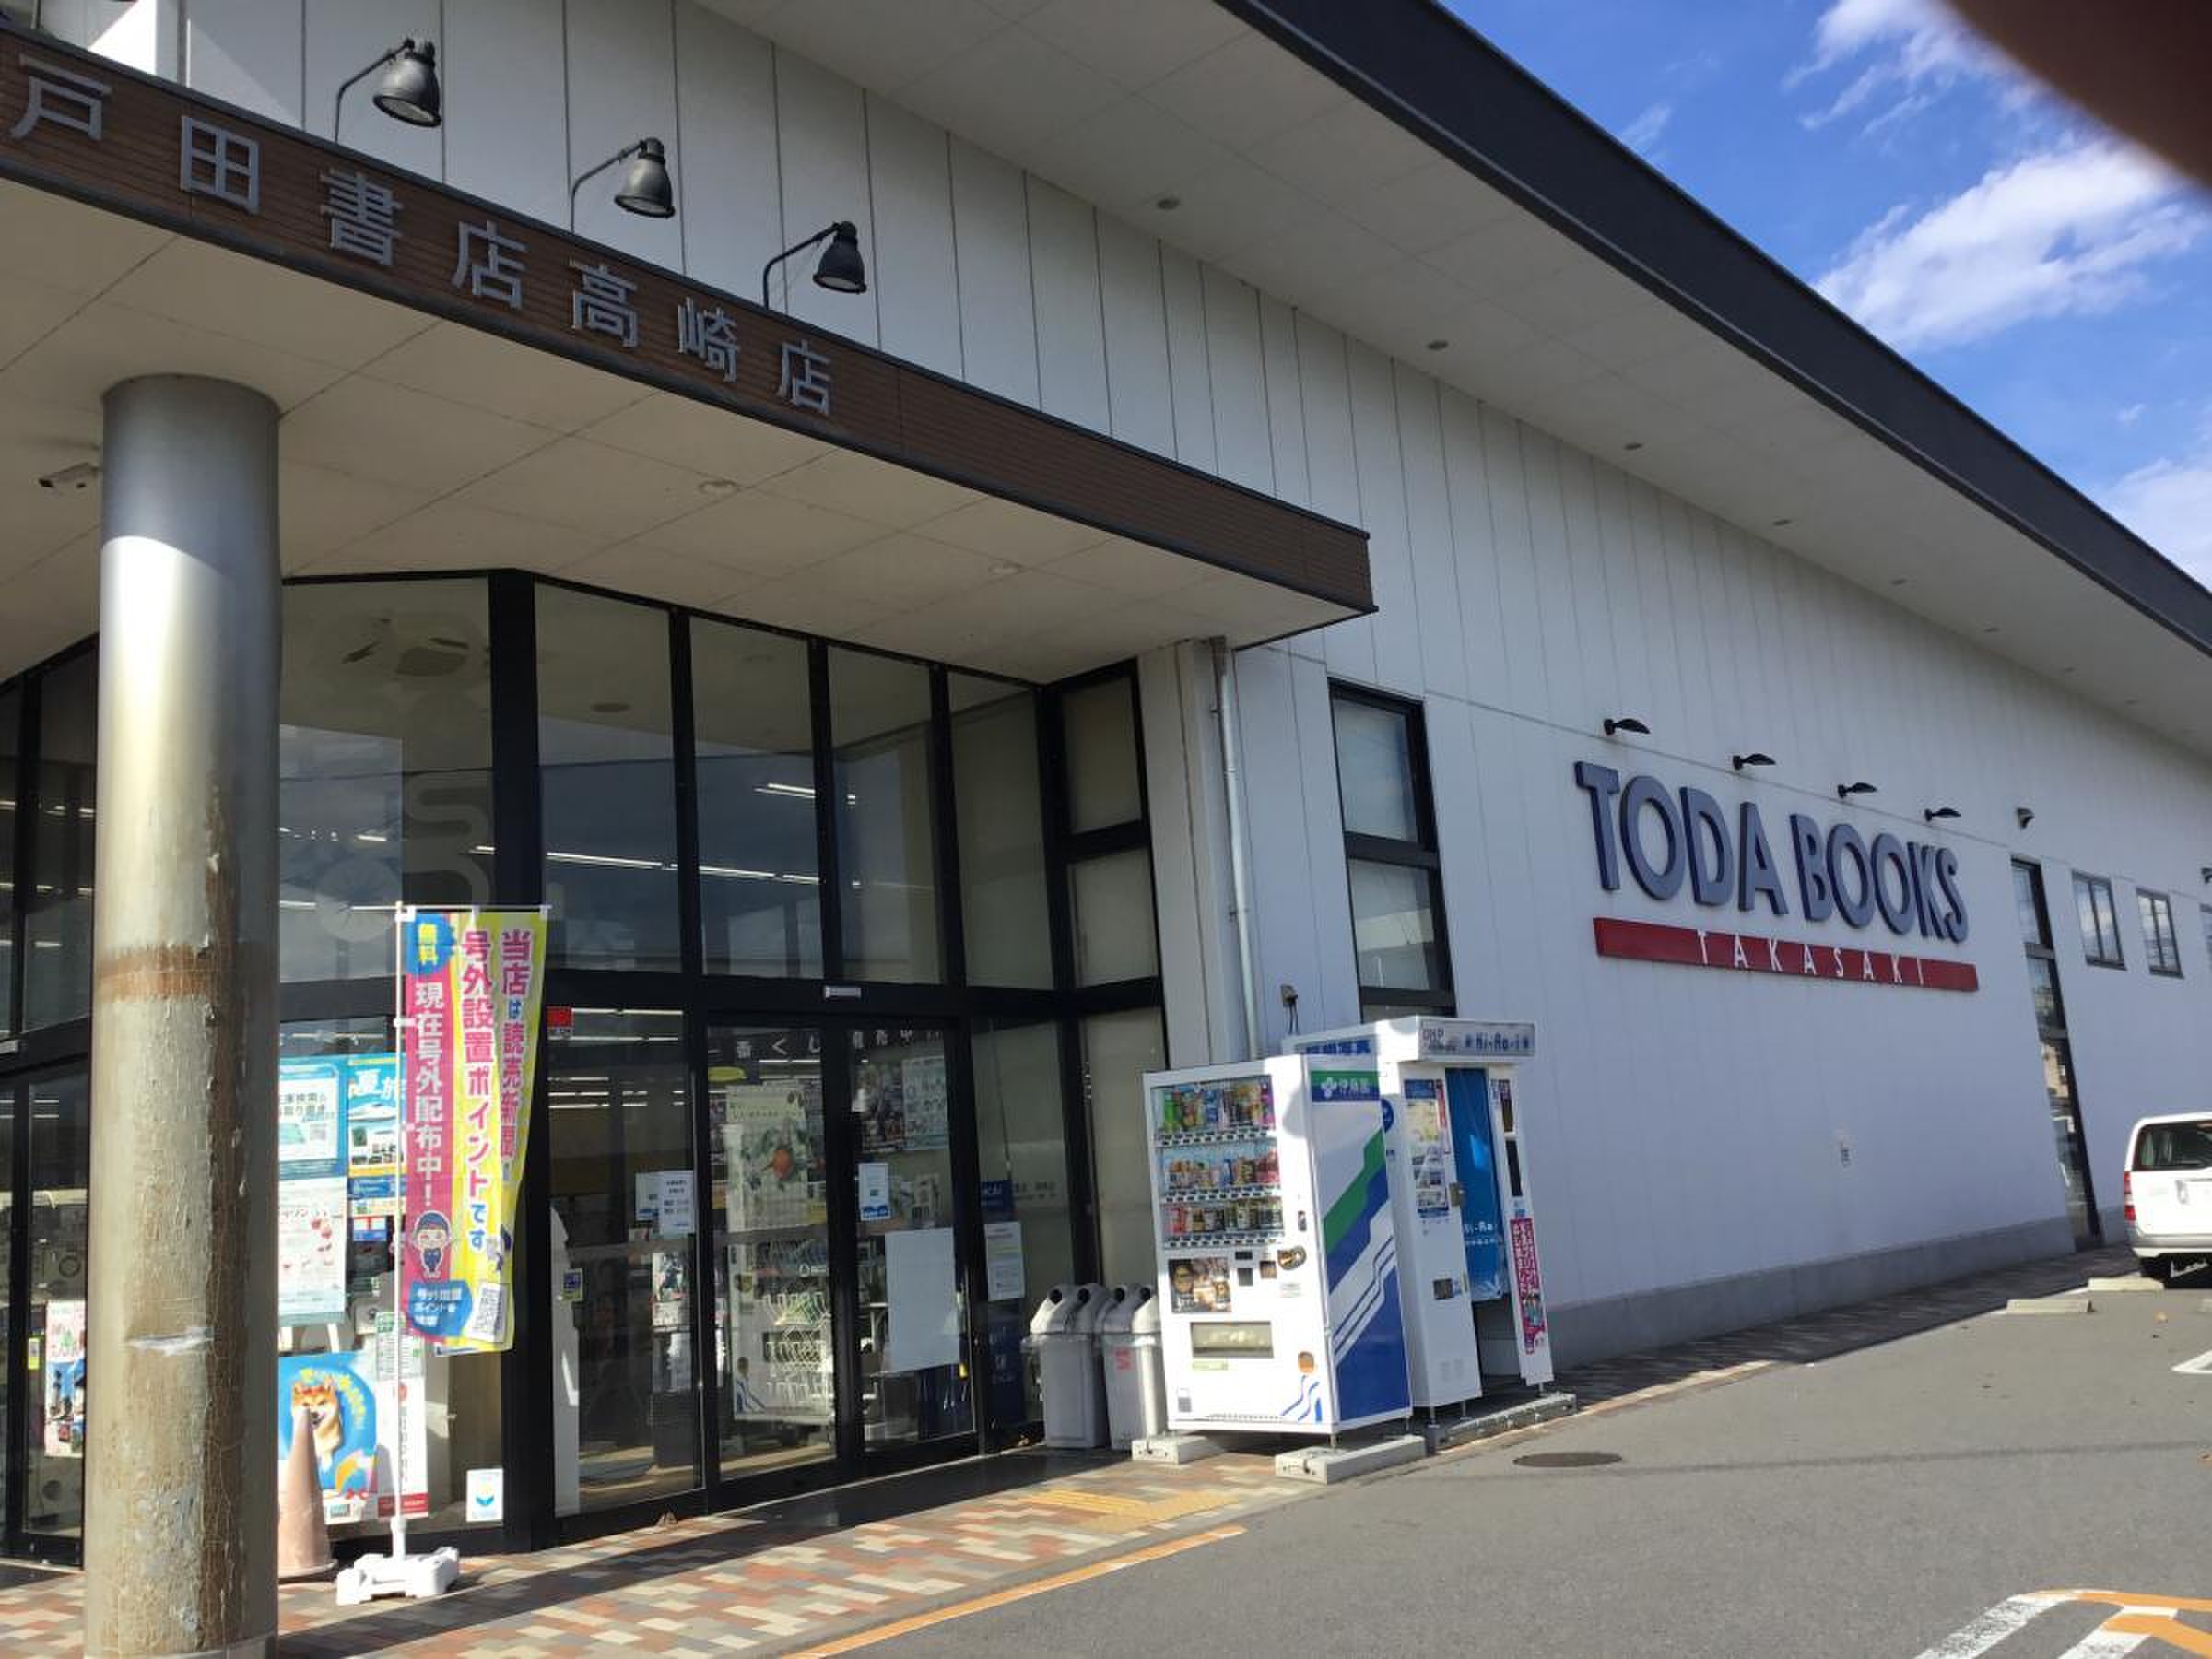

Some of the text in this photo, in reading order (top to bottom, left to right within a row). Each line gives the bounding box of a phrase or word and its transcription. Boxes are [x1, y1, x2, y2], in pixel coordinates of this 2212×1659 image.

[9, 53, 831, 417] 戸田書店高崎店
[1574, 760, 1969, 944] TODA BOOKS
[1697, 929, 1924, 985] TAKASAKI
[463, 930, 493, 1249] 号外設置ポイントです
